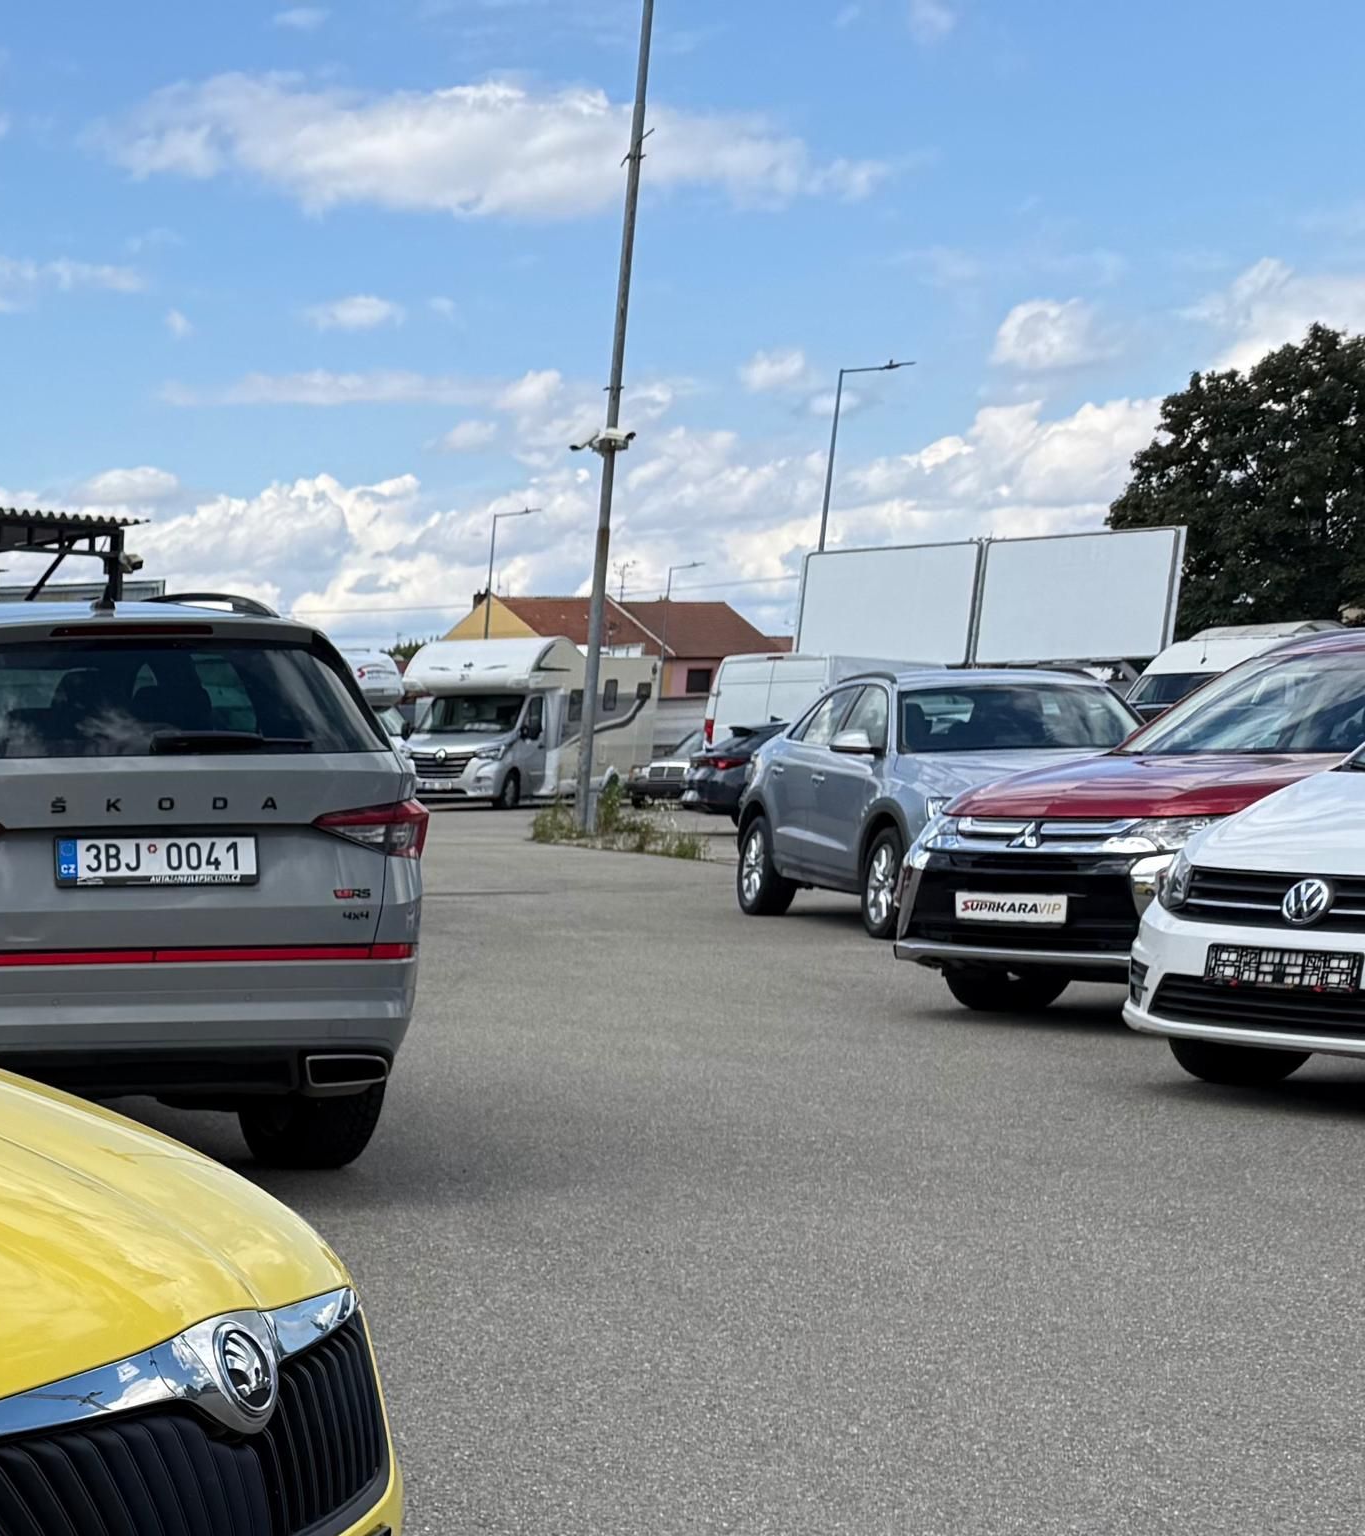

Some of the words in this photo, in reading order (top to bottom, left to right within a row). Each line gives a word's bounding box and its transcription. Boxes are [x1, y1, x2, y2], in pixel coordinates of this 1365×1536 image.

[85, 843, 141, 873] 3BJ
[166, 841, 240, 872] 0041
[60, 864, 76, 874] CZ
